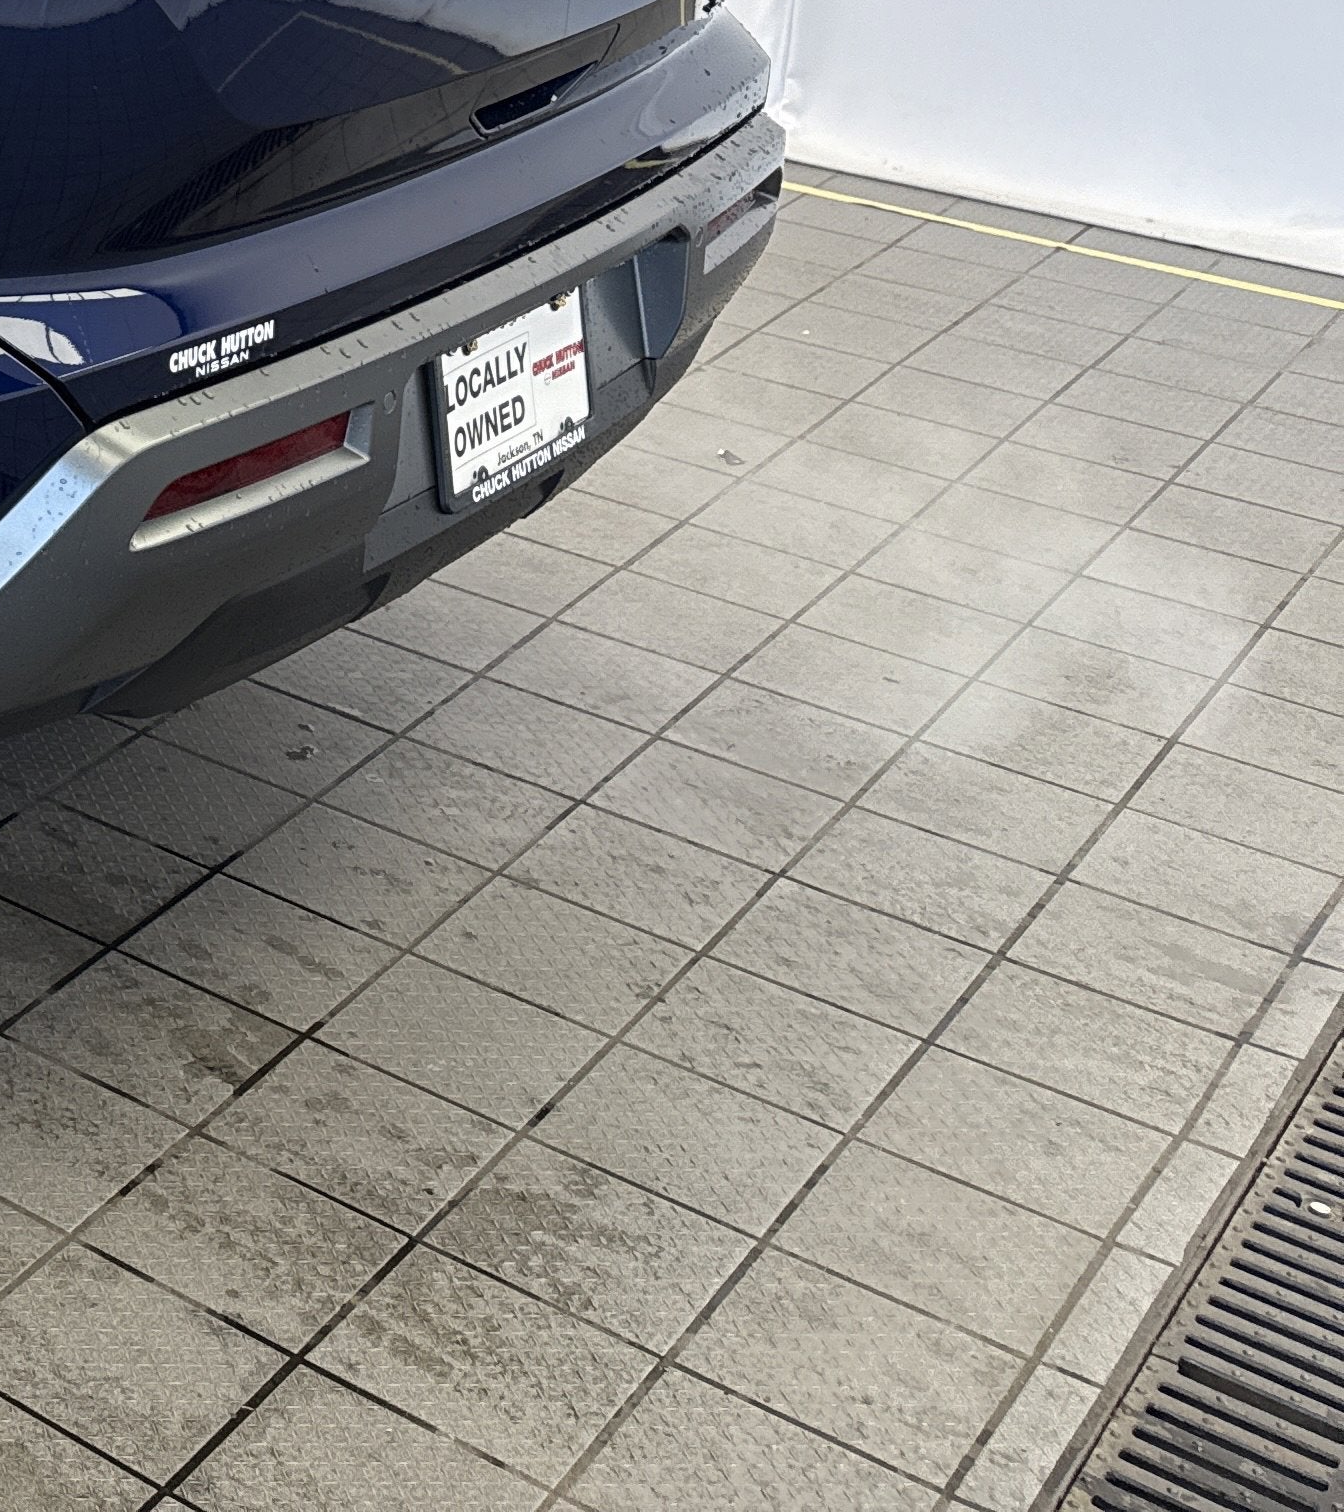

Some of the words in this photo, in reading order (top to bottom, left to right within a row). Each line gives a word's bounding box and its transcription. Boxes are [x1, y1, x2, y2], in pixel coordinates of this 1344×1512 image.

[169, 339, 217, 374] CHUCK
[220, 319, 275, 357] HUTTON
[195, 349, 250, 378] NISSAN
[443, 341, 528, 415] LOCALLY
[454, 394, 526, 458] OWNED
[472, 474, 511, 503] CHUCK
[511, 449, 552, 482] HUTTON
[552, 425, 587, 458] NISSAN
